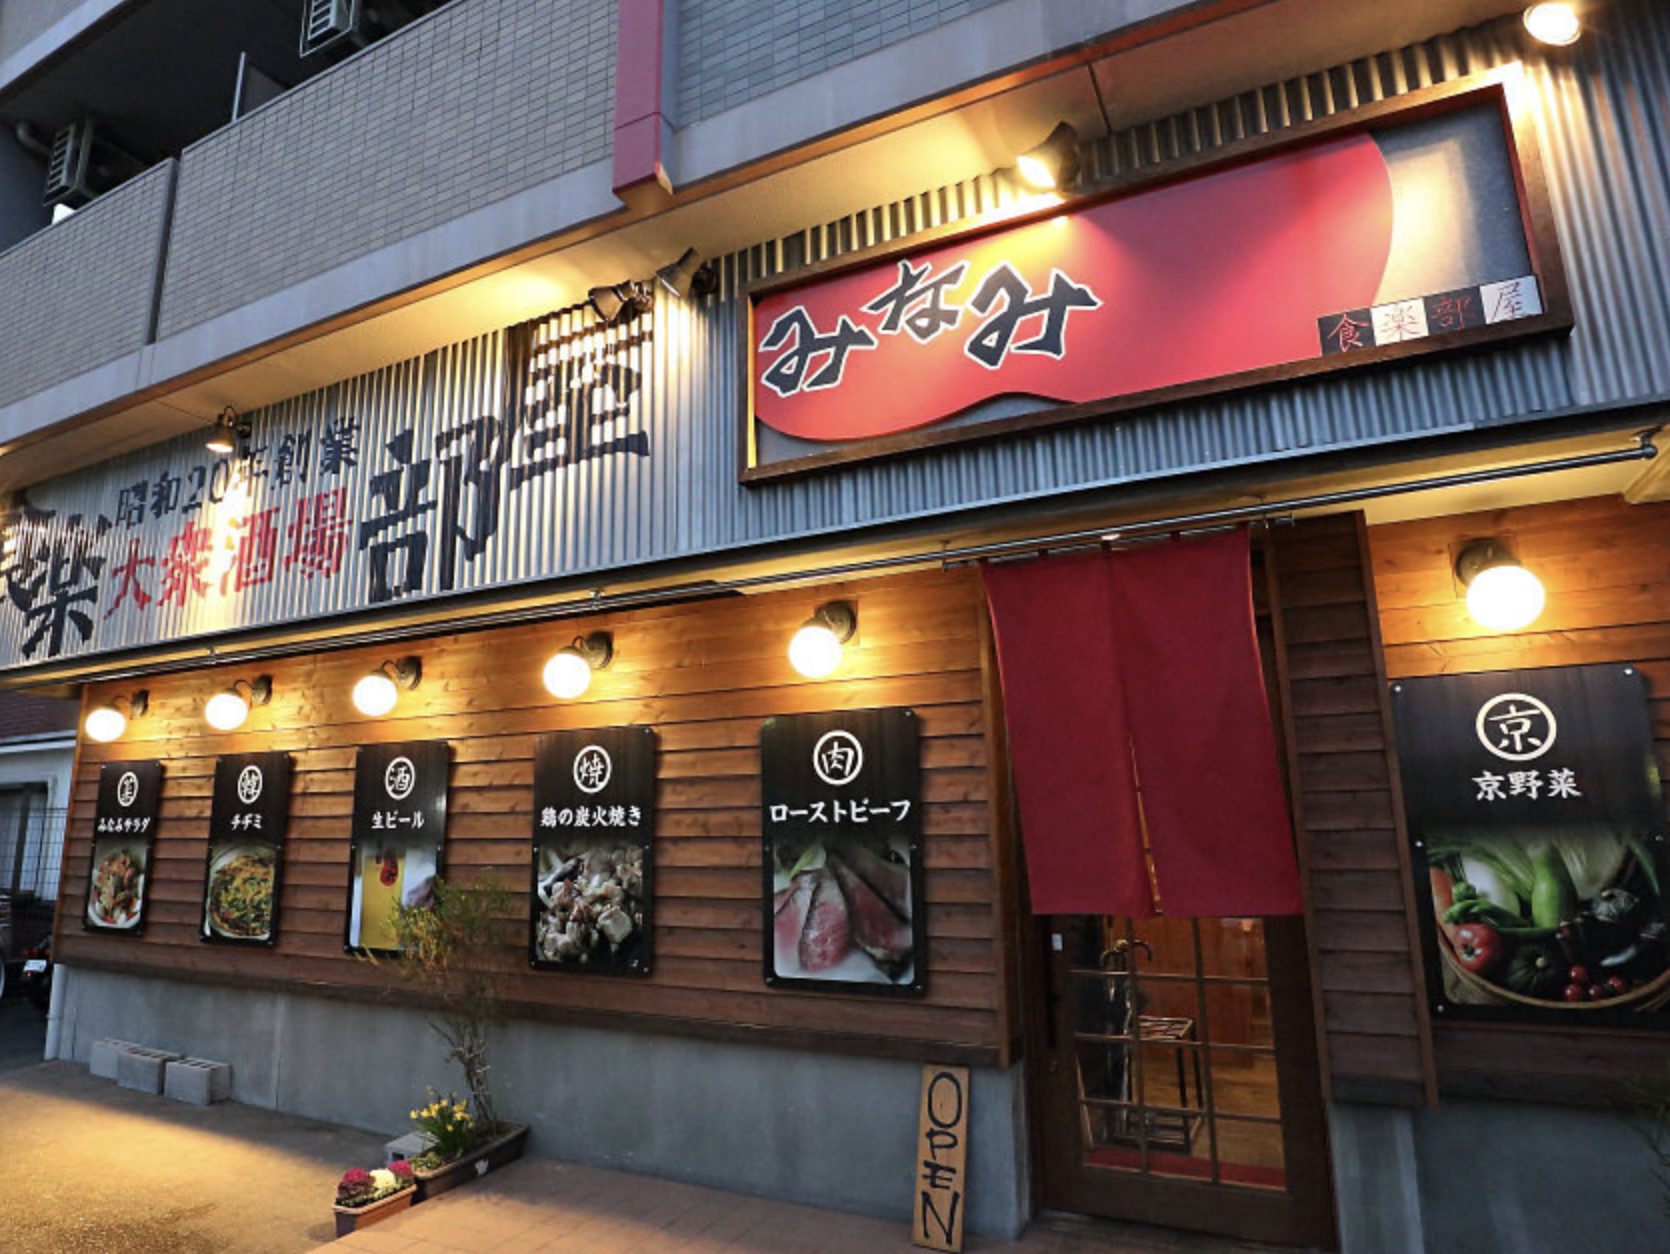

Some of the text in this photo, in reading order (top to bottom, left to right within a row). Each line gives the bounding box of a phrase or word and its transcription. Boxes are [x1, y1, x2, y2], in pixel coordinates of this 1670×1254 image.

[759, 260, 1103, 397] みなみ
[1326, 279, 1525, 353] 食楽部屋
[1487, 702, 1544, 754] 京
[819, 739, 856, 778] 肉
[387, 763, 412, 793] 酒
[1471, 767, 1583, 801] 京野菜
[371, 809, 425, 829] 生ビール
[540, 805, 642, 829] 鶏の炭火焼き
[769, 797, 911, 823] ローストビーフ
[920, 1071, 963, 1246] OPEN
